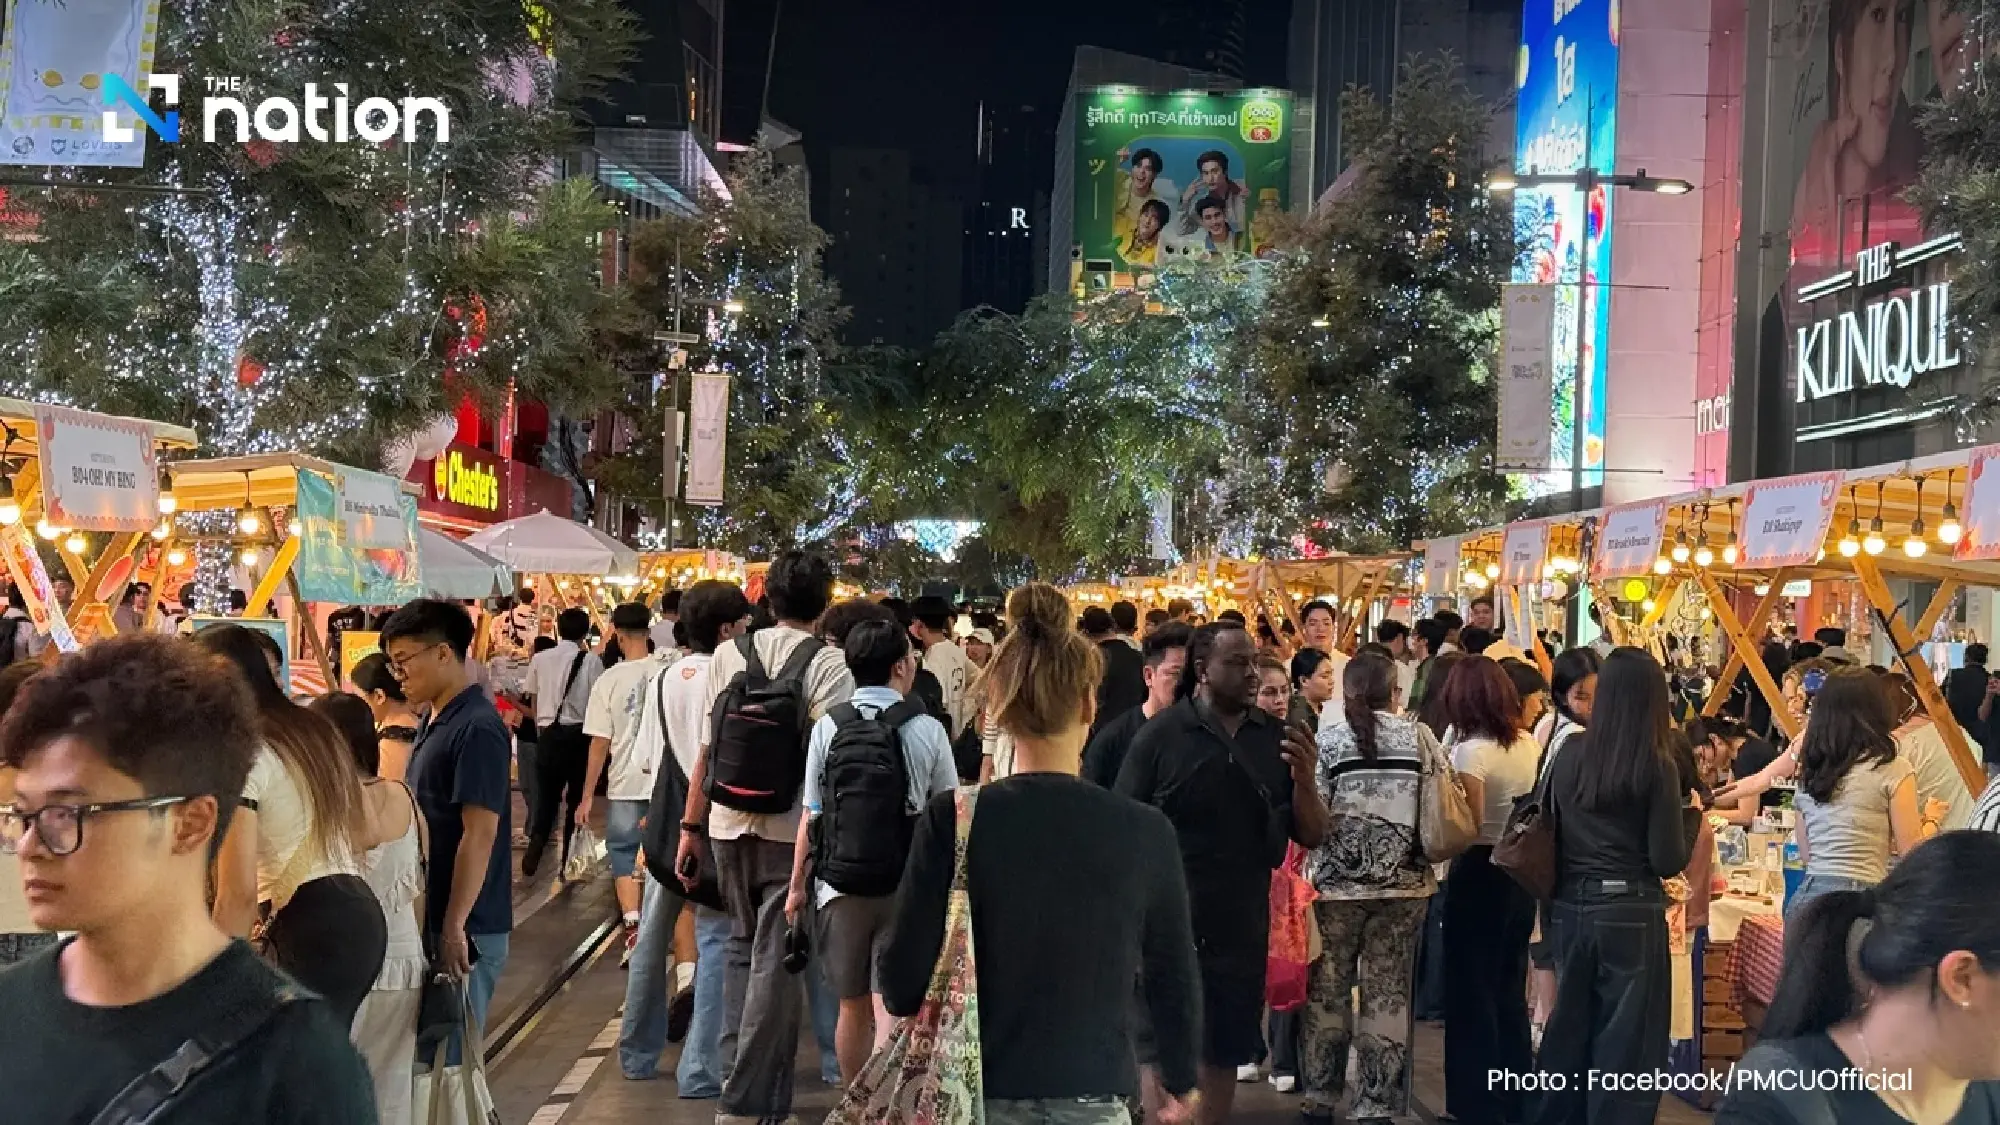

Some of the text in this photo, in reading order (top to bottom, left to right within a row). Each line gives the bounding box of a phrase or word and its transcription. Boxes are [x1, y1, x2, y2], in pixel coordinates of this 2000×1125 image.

[1011, 207, 1031, 229] R
[1856, 241, 1893, 287] THE
[448, 450, 498, 512] Chester's
